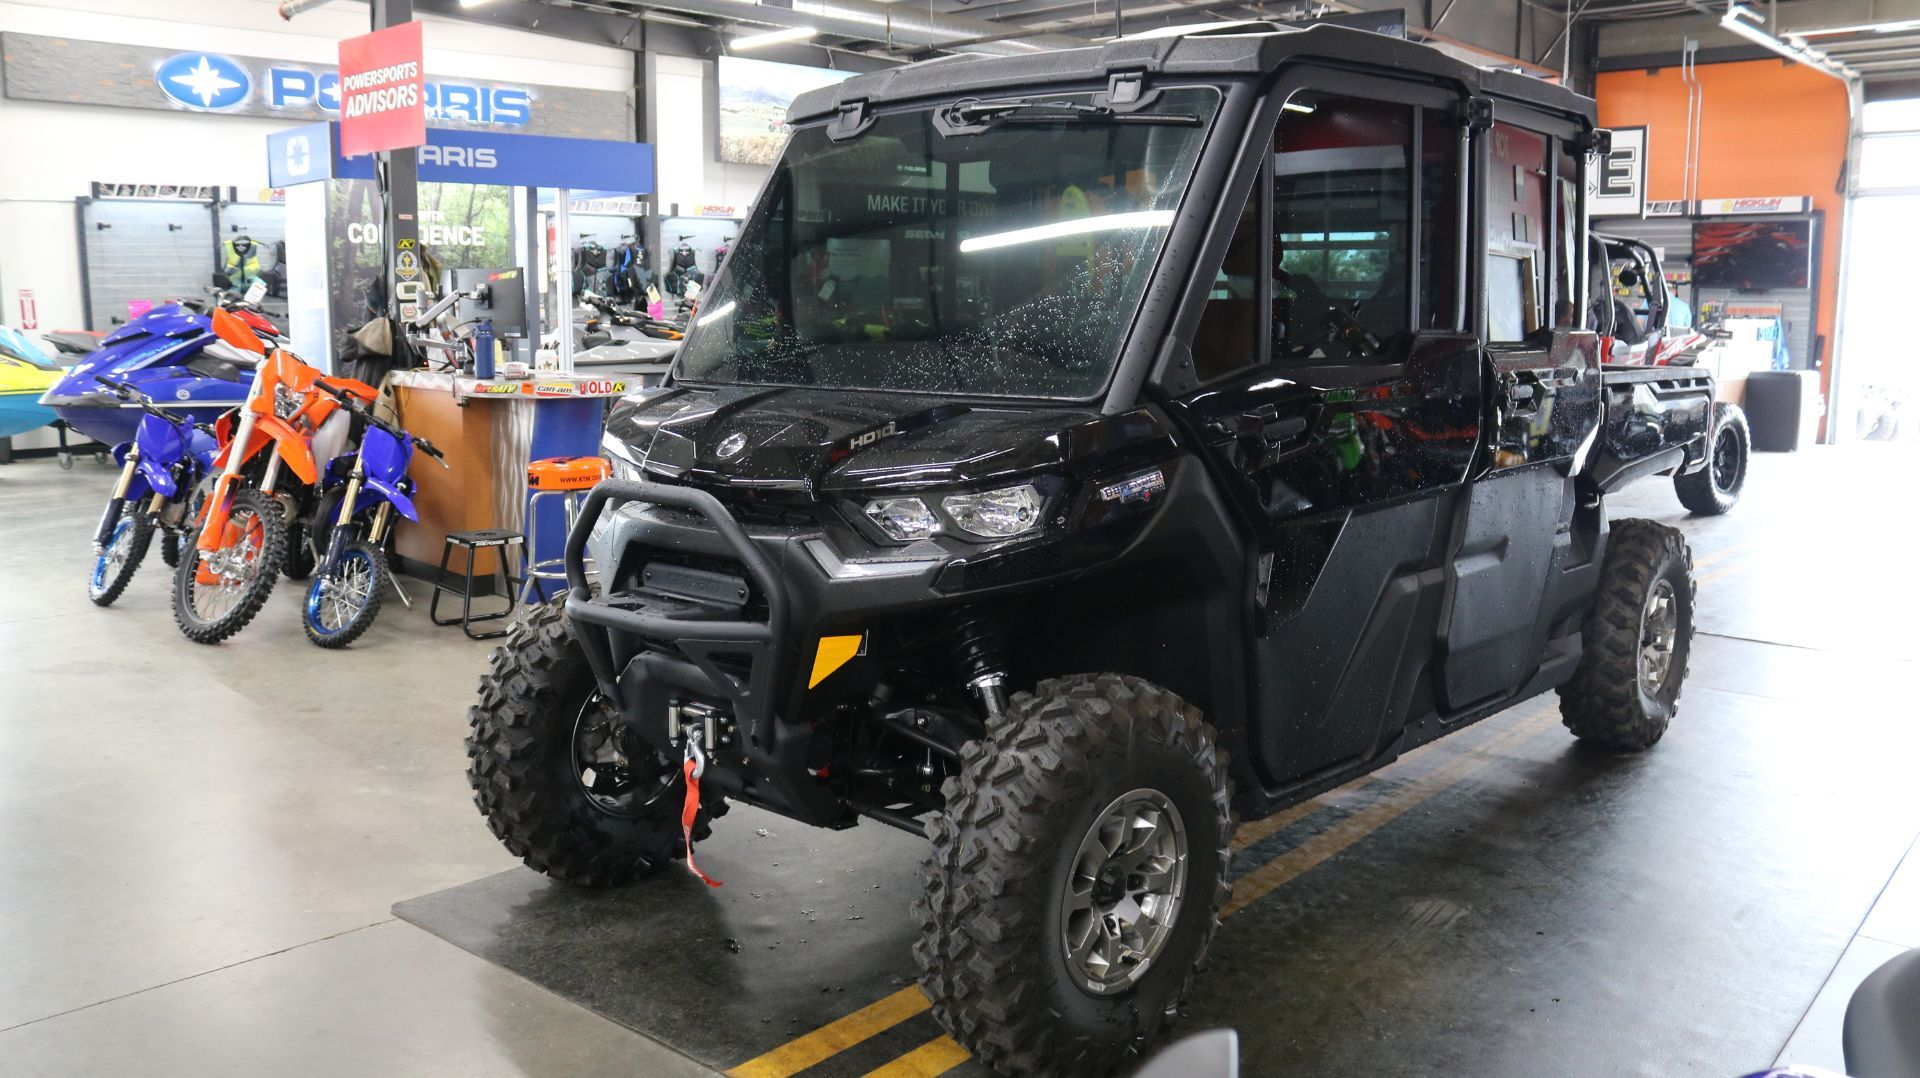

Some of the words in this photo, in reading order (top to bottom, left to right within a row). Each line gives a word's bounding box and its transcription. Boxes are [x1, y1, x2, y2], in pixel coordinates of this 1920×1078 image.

[343, 61, 418, 92] POWERSPORTS
[269, 67, 531, 126] PORIS
[345, 82, 418, 118] ADVISORS
[867, 194, 909, 213] MAKE
[911, 196, 927, 214] IT
[930, 198, 966, 217] YOR
[347, 222, 486, 246] CODENCE
